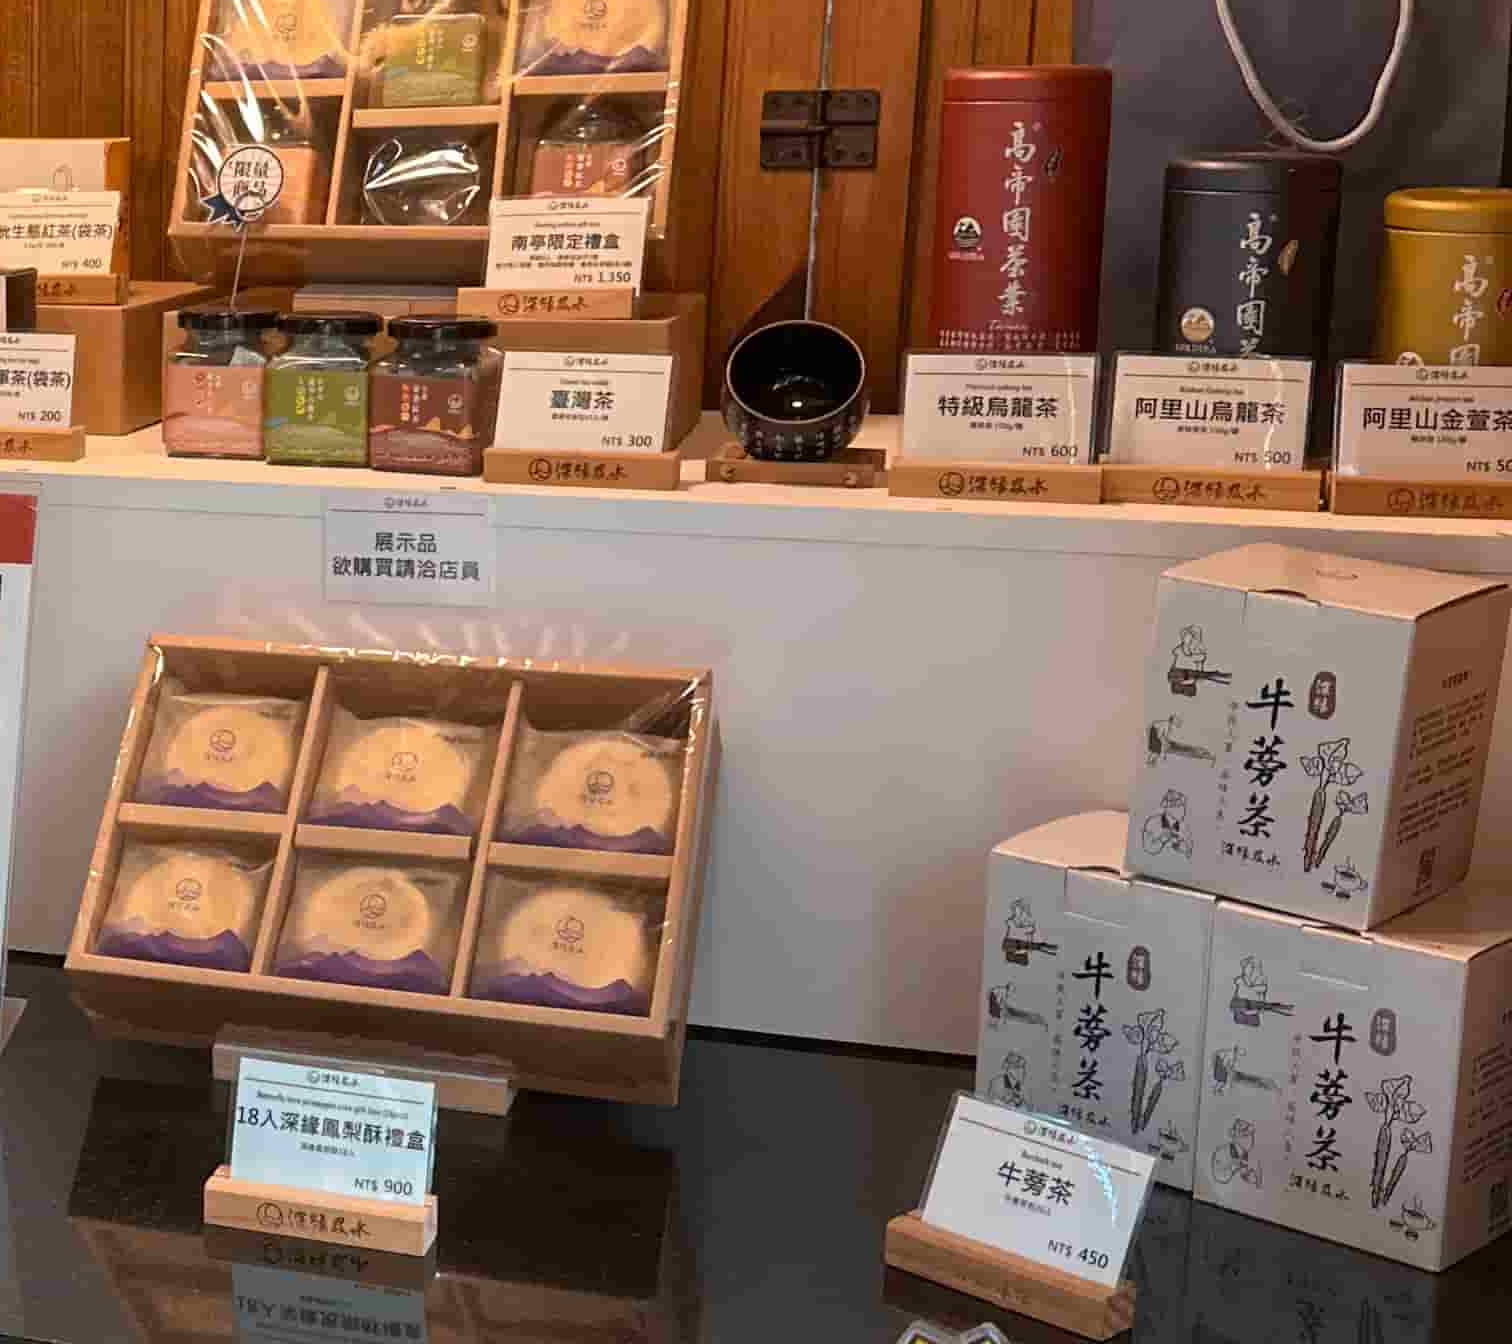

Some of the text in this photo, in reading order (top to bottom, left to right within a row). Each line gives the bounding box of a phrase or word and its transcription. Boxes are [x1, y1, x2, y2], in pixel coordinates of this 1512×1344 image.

[511, 233, 620, 251] 南亭限定禮盒
[82, 258, 102, 268] 400
[550, 390, 616, 410] 臺灣茶
[938, 396, 1059, 418] 特級烏龍茶
[40, 410, 61, 421] 200
[1136, 398, 1287, 424] 阿里山烏龍茶
[1363, 407, 1512, 432] 阿里山金萱茶
[601, 435, 653, 448] NT$ 300
[1023, 445, 1079, 457] NT$ 600
[1234, 452, 1291, 464] NT$ 500
[1466, 461, 1491, 472] NT$
[375, 532, 437, 553] 展示品
[332, 557, 480, 580] 欲購買請洽店員
[1237, 677, 1295, 840] 牛蒡茶
[1072, 951, 1115, 1102] 牛蒡茶
[1304, 1012, 1359, 1173] 牛蒡茶
[238, 1106, 425, 1151] 18入深緣鳳梨酥禮盒
[354, 1178, 412, 1196] NT$ 900
[997, 1159, 1075, 1206] 牛蒡茶
[1048, 1239, 1109, 1269] NT$ 450
